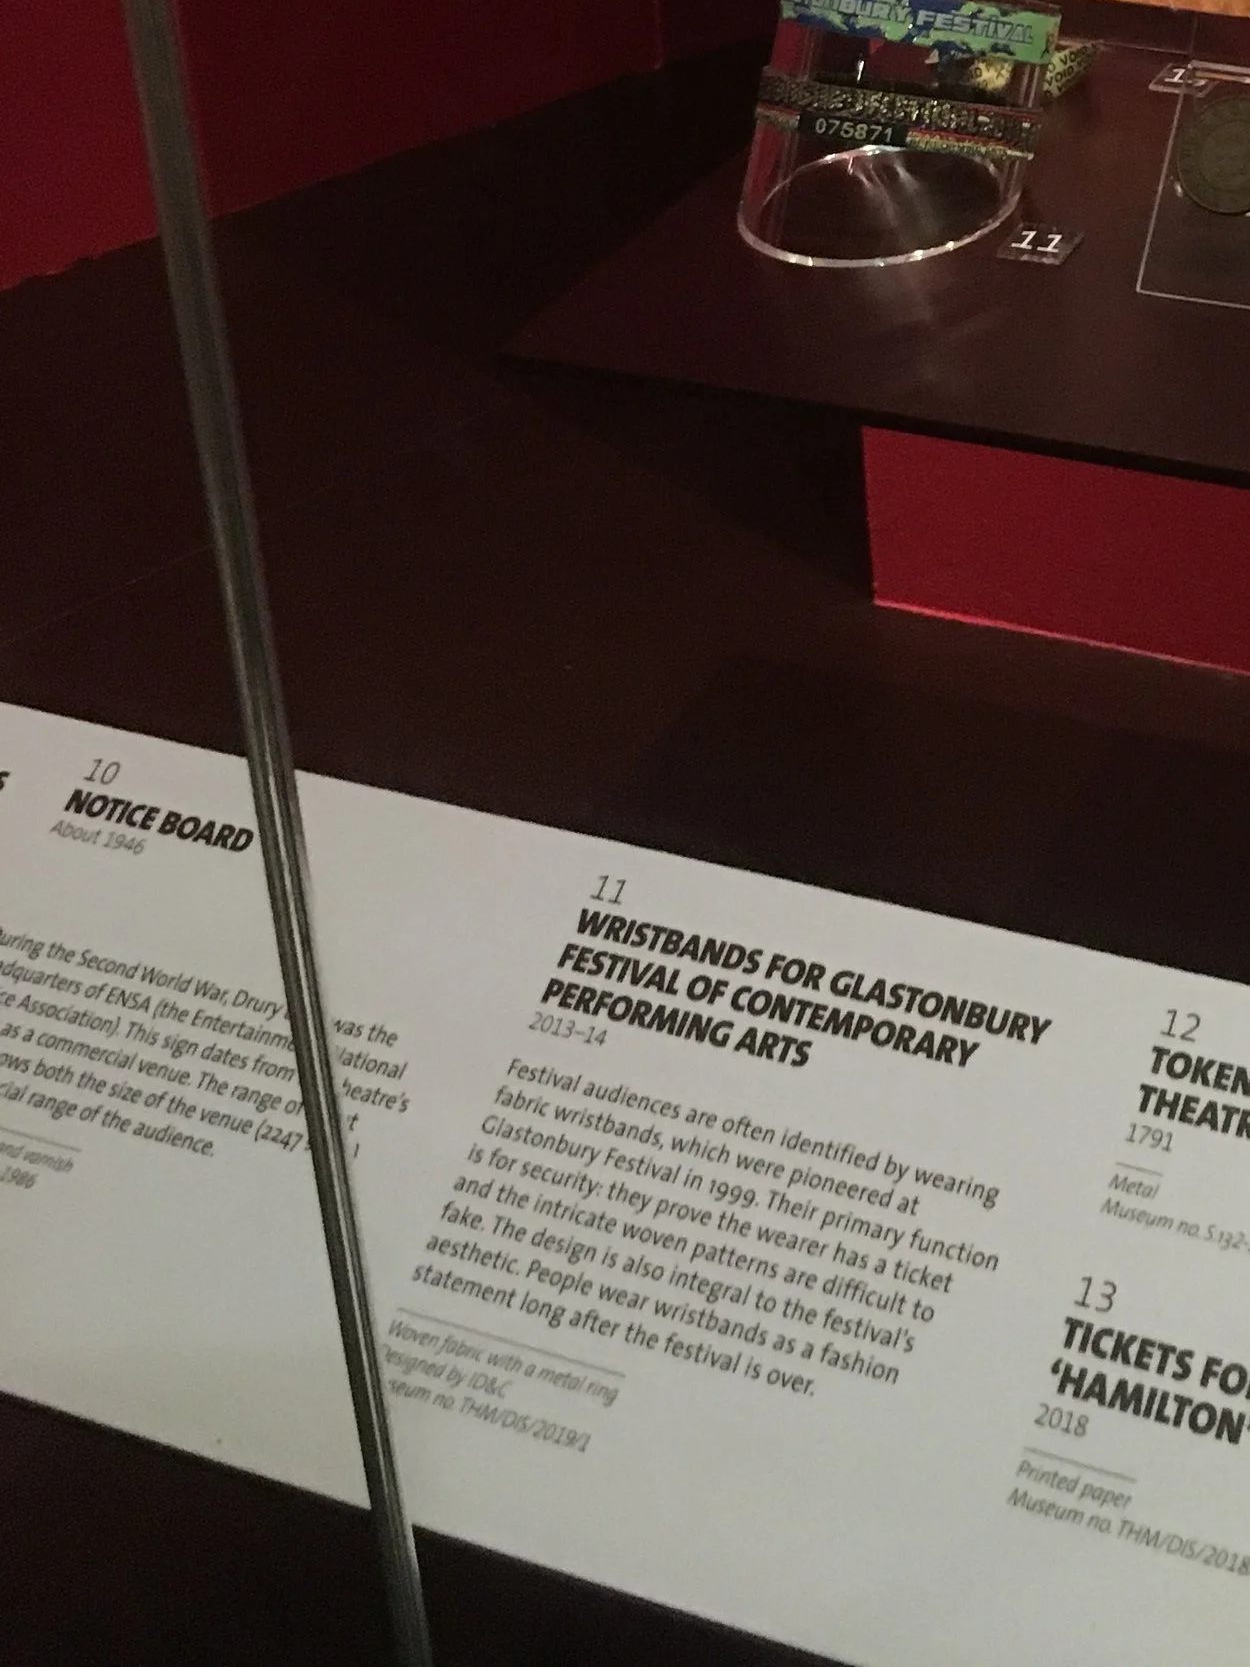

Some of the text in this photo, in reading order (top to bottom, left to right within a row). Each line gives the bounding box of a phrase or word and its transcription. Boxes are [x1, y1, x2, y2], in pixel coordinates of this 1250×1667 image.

[1011, 230, 1063, 254] 11
[83, 759, 121, 785] 10
[50, 820, 146, 855] About 1946
[64, 789, 254, 852] NOTICE BOARD
[590, 875, 626, 905] 11
[77, 949, 140, 979] Second
[141, 966, 193, 993] World
[194, 980, 229, 1006] War,
[232, 989, 285, 1021] Drury
[105, 987, 151, 1013] ENSA
[557, 943, 980, 1067] FESTIVAL OF CONTEMPORARY
[577, 909, 1052, 1044] WRISTBANDS FOR GLASTONBURY
[17, 994, 296, 1082] Association). sign dates from
[541, 978, 812, 1066] PERFORMING ARTS
[1160, 1009, 1201, 1043] 12
[36, 1034, 192, 1086] commercial venue.
[27, 1091, 215, 1157] range audience.
[33, 1059, 304, 1153] both size (2247
[507, 1059, 999, 1209] Festival audiences often identified wearing
[1125, 1123, 1173, 1152] 1791
[495, 1086, 894, 1208] fabric wristbands, which were pioneered
[482, 1115, 998, 1271] Glastonbury Festival 1999. Their primary function
[1108, 1174, 1159, 1198] Metal
[454, 1177, 906, 1315] and intricate woven patterns difficult
[488, 1148, 952, 1293] for security: they prove wearer has ticket
[426, 1236, 899, 1384] aesthetic. People wear wristbands fashion
[441, 1201, 914, 1353] fake. The design also integral festival's
[1074, 1276, 1117, 1313] 13
[413, 1265, 814, 1396] statement long after festival over.
[1064, 1317, 1194, 1381] TICKETS
[1034, 1403, 1089, 1438] 2018
[1016, 1460, 1132, 1509] Printed paper
